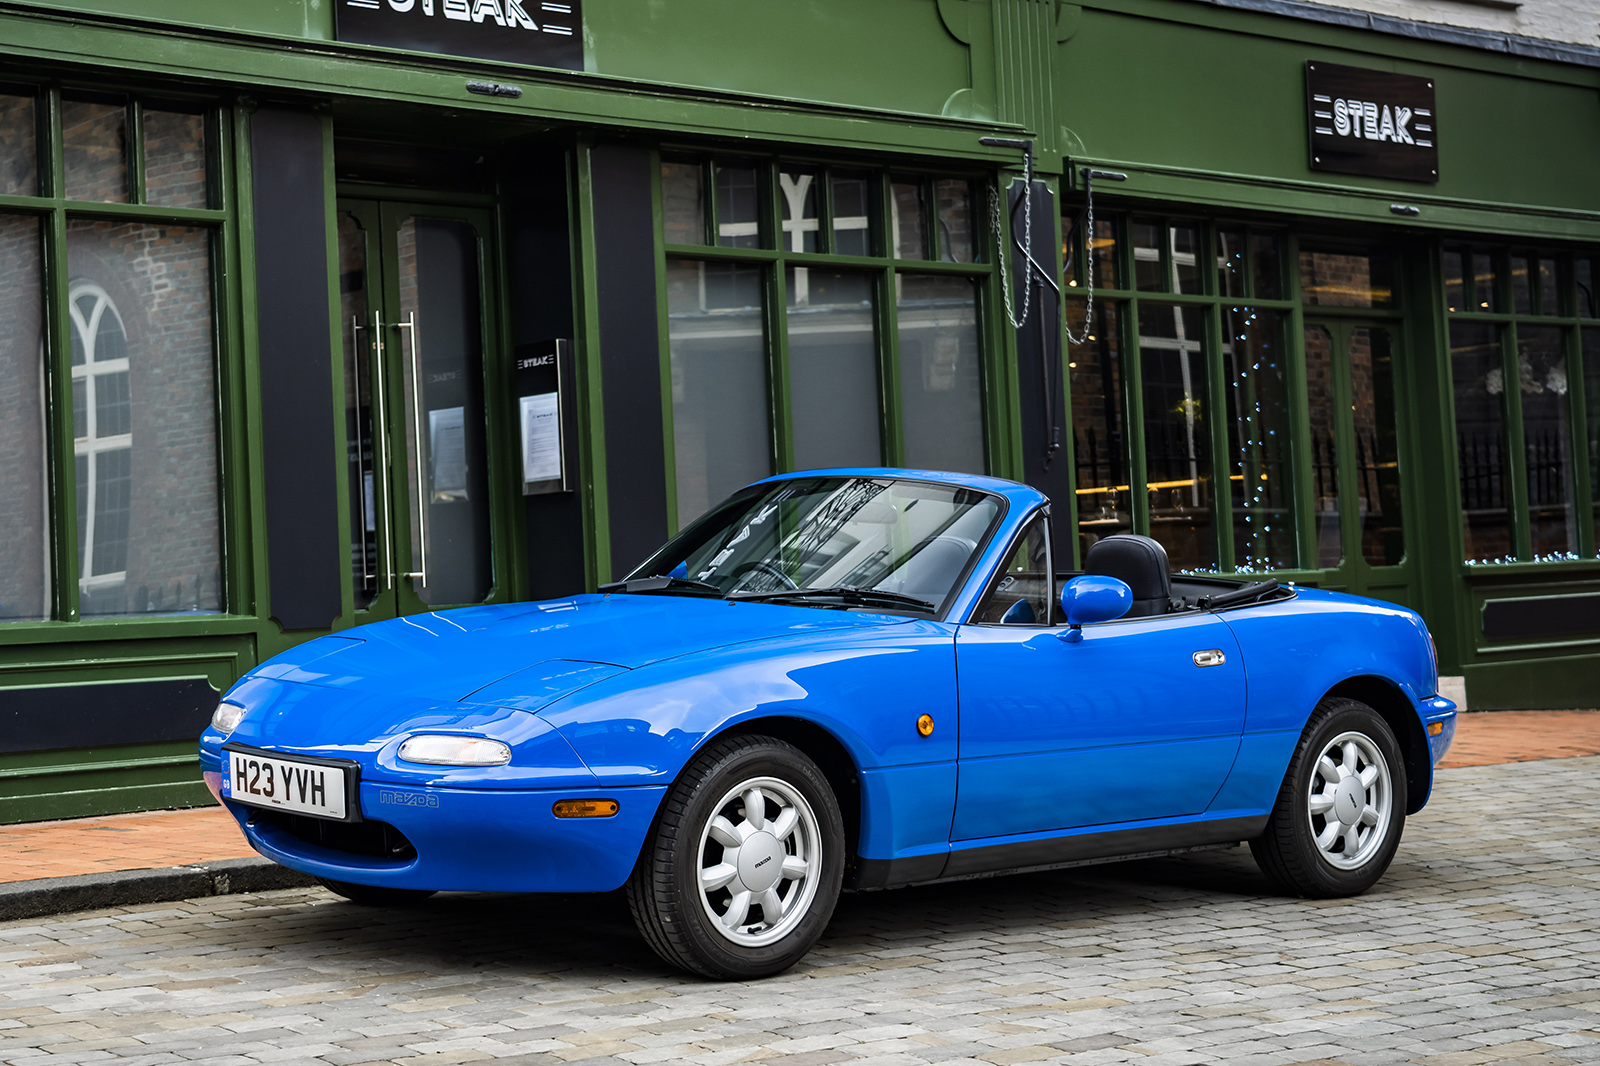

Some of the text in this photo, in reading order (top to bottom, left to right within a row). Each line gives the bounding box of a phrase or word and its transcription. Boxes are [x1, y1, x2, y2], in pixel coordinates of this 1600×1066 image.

[1334, 98, 1415, 145] STEAK
[523, 356, 548, 368] STEAK
[236, 757, 325, 807] H23 YVH
